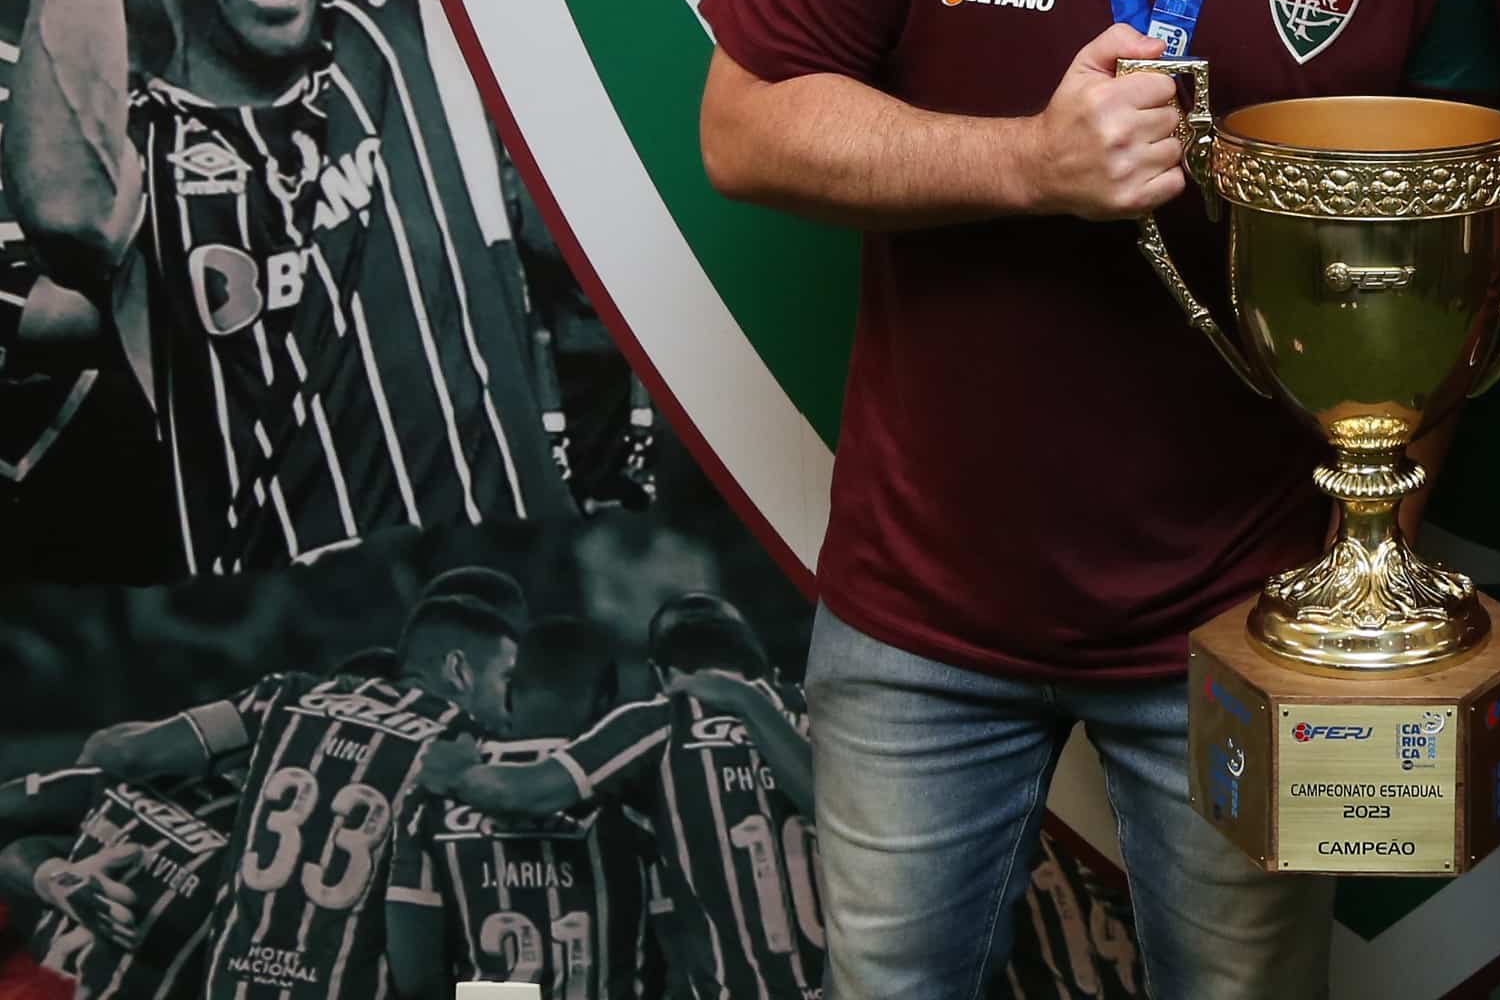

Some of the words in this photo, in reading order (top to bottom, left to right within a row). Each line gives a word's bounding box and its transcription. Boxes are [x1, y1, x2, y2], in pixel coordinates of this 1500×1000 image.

[1310, 726, 1373, 740] FERJ
[1402, 736, 1428, 748] RIO
[1291, 783, 1376, 798] CAMPEONATO
[1379, 784, 1444, 798] ESTADUAL
[1343, 805, 1391, 818] 2023
[242, 767, 390, 909] 33
[1318, 838, 1416, 855] CAMPEÃO
[481, 861, 498, 888] J.
[506, 861, 574, 888] ARIAS
[227, 957, 318, 983] NACIONAL
